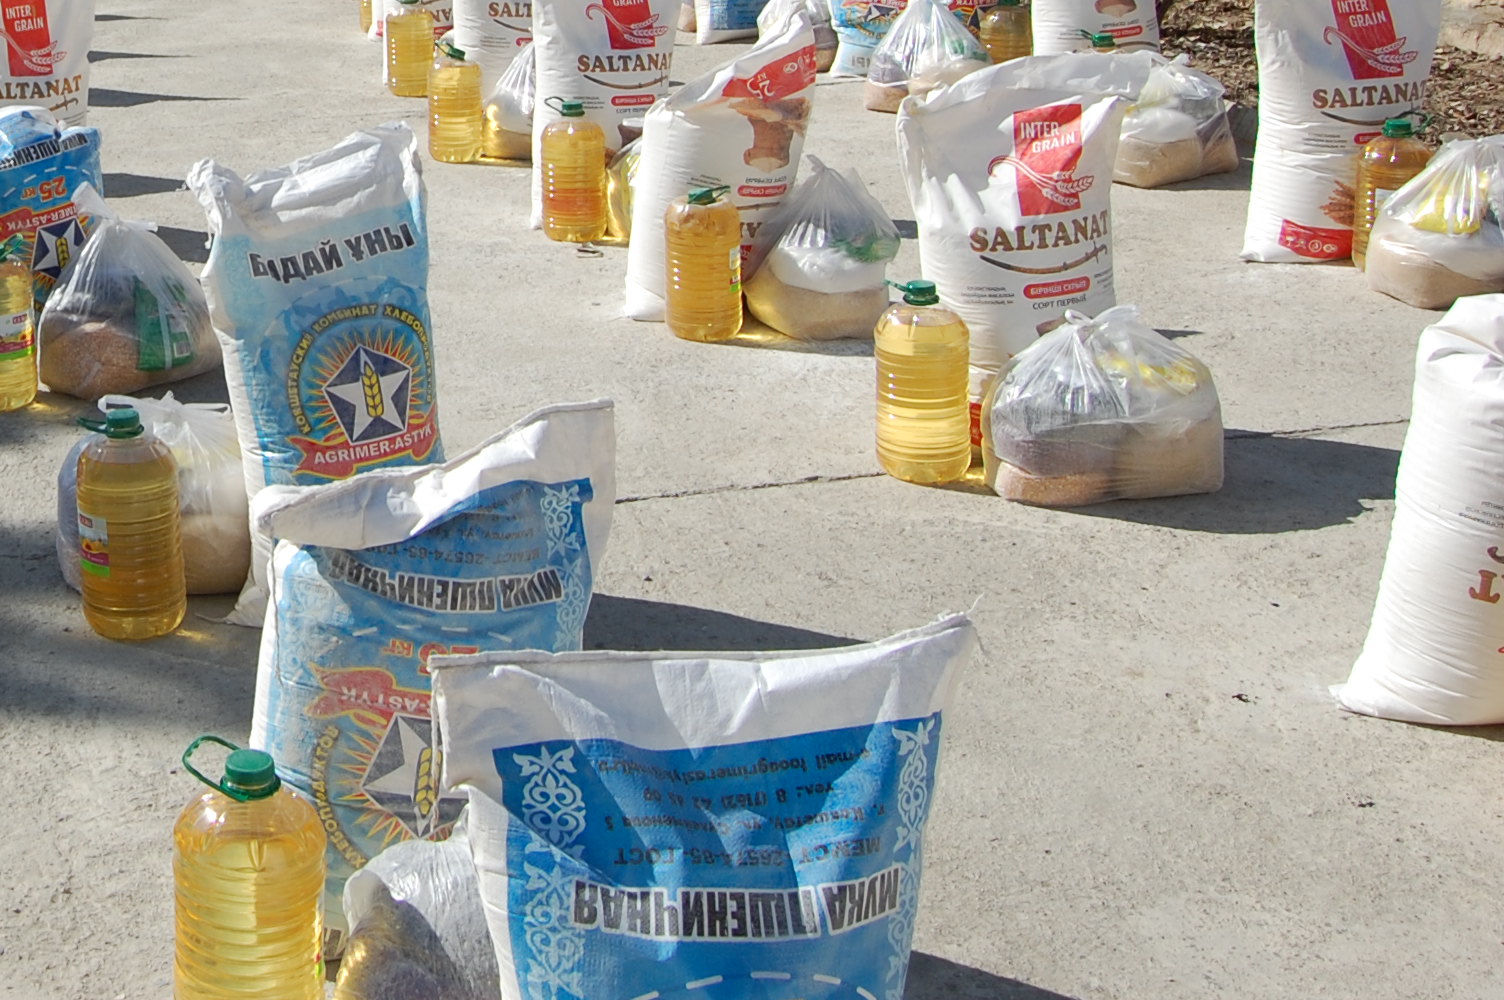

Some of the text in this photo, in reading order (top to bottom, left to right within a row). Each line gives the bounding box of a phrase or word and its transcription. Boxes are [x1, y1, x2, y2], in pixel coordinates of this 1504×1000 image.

[5, 5, 32, 19] INTER
[488, 1, 532, 18] SALT
[1336, 0, 1370, 13] INTER
[14, 16, 44, 32] GRAIN
[1349, 11, 1387, 28] GRAIN
[747, 77, 774, 100] 25
[1020, 121, 1060, 138] INTER
[1032, 132, 1076, 153] GRAIN
[40, 175, 67, 199] 25
[7, 207, 76, 231] IMER-ASTYK
[969, 209, 1109, 252] SALTANAT
[343, 223, 415, 262] ҰНЫ
[1032, 301, 1055, 310] СОРТ
[312, 304, 378, 333] КОМБИНАТ
[314, 424, 432, 465] AGRIMER-ASTYK
[498, 568, 563, 611] МУКА
[776, 788, 786, 803] 8
[613, 847, 675, 865] ГОСТ
[573, 867, 899, 938] МУКА ПШЕНИЧНАЯ
